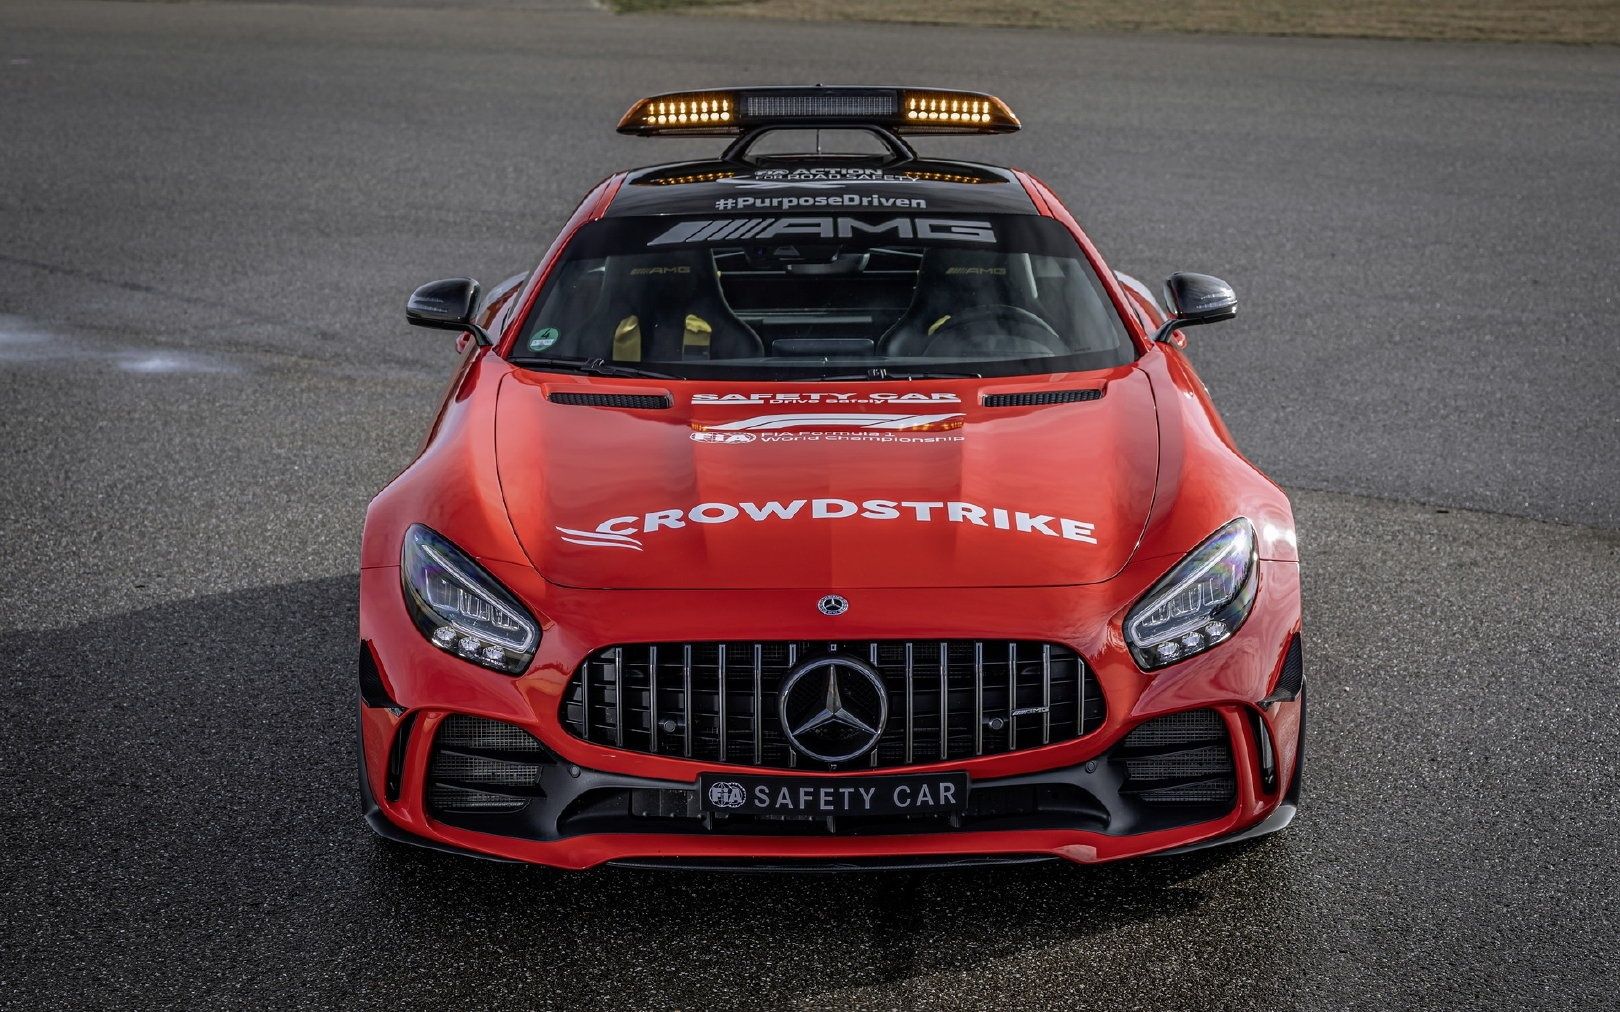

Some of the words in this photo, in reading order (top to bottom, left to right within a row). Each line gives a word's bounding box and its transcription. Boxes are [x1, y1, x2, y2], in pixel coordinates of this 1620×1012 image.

[846, 173, 920, 182] SAFETY
[715, 194, 927, 210] #PurposeDriven
[541, 329, 550, 339] 4
[869, 392, 958, 400] CAR
[595, 499, 1098, 545] CROWDSTRIKE
[754, 785, 876, 810] SAFETY
[893, 782, 957, 807] CAR
